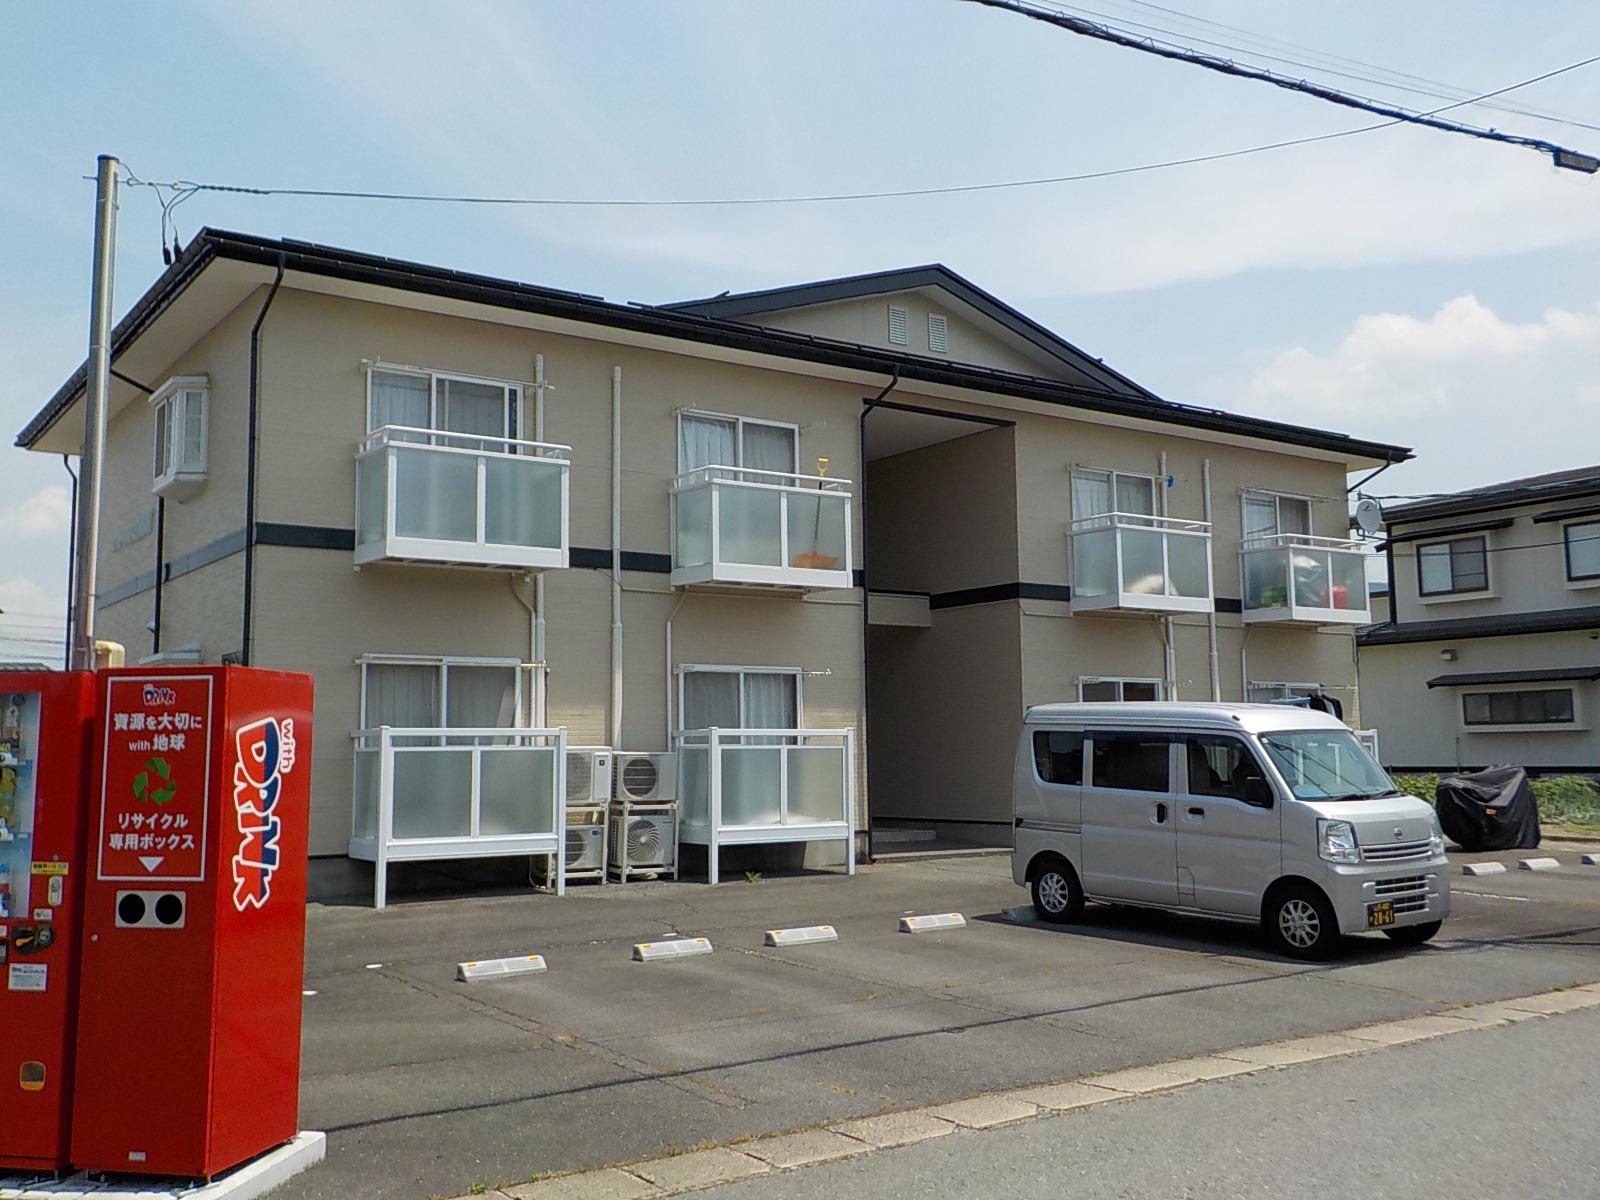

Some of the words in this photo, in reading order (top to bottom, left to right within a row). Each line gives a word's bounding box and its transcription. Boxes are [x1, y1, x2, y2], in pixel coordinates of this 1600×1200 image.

[114, 711, 203, 731] 資源を大切に
[128, 739, 151, 752] with
[152, 732, 186, 751] 地球
[281, 719, 295, 772] with
[118, 812, 189, 830] リサイクル
[232, 716, 282, 912] DRINK
[109, 832, 195, 851] 専用ボックス
